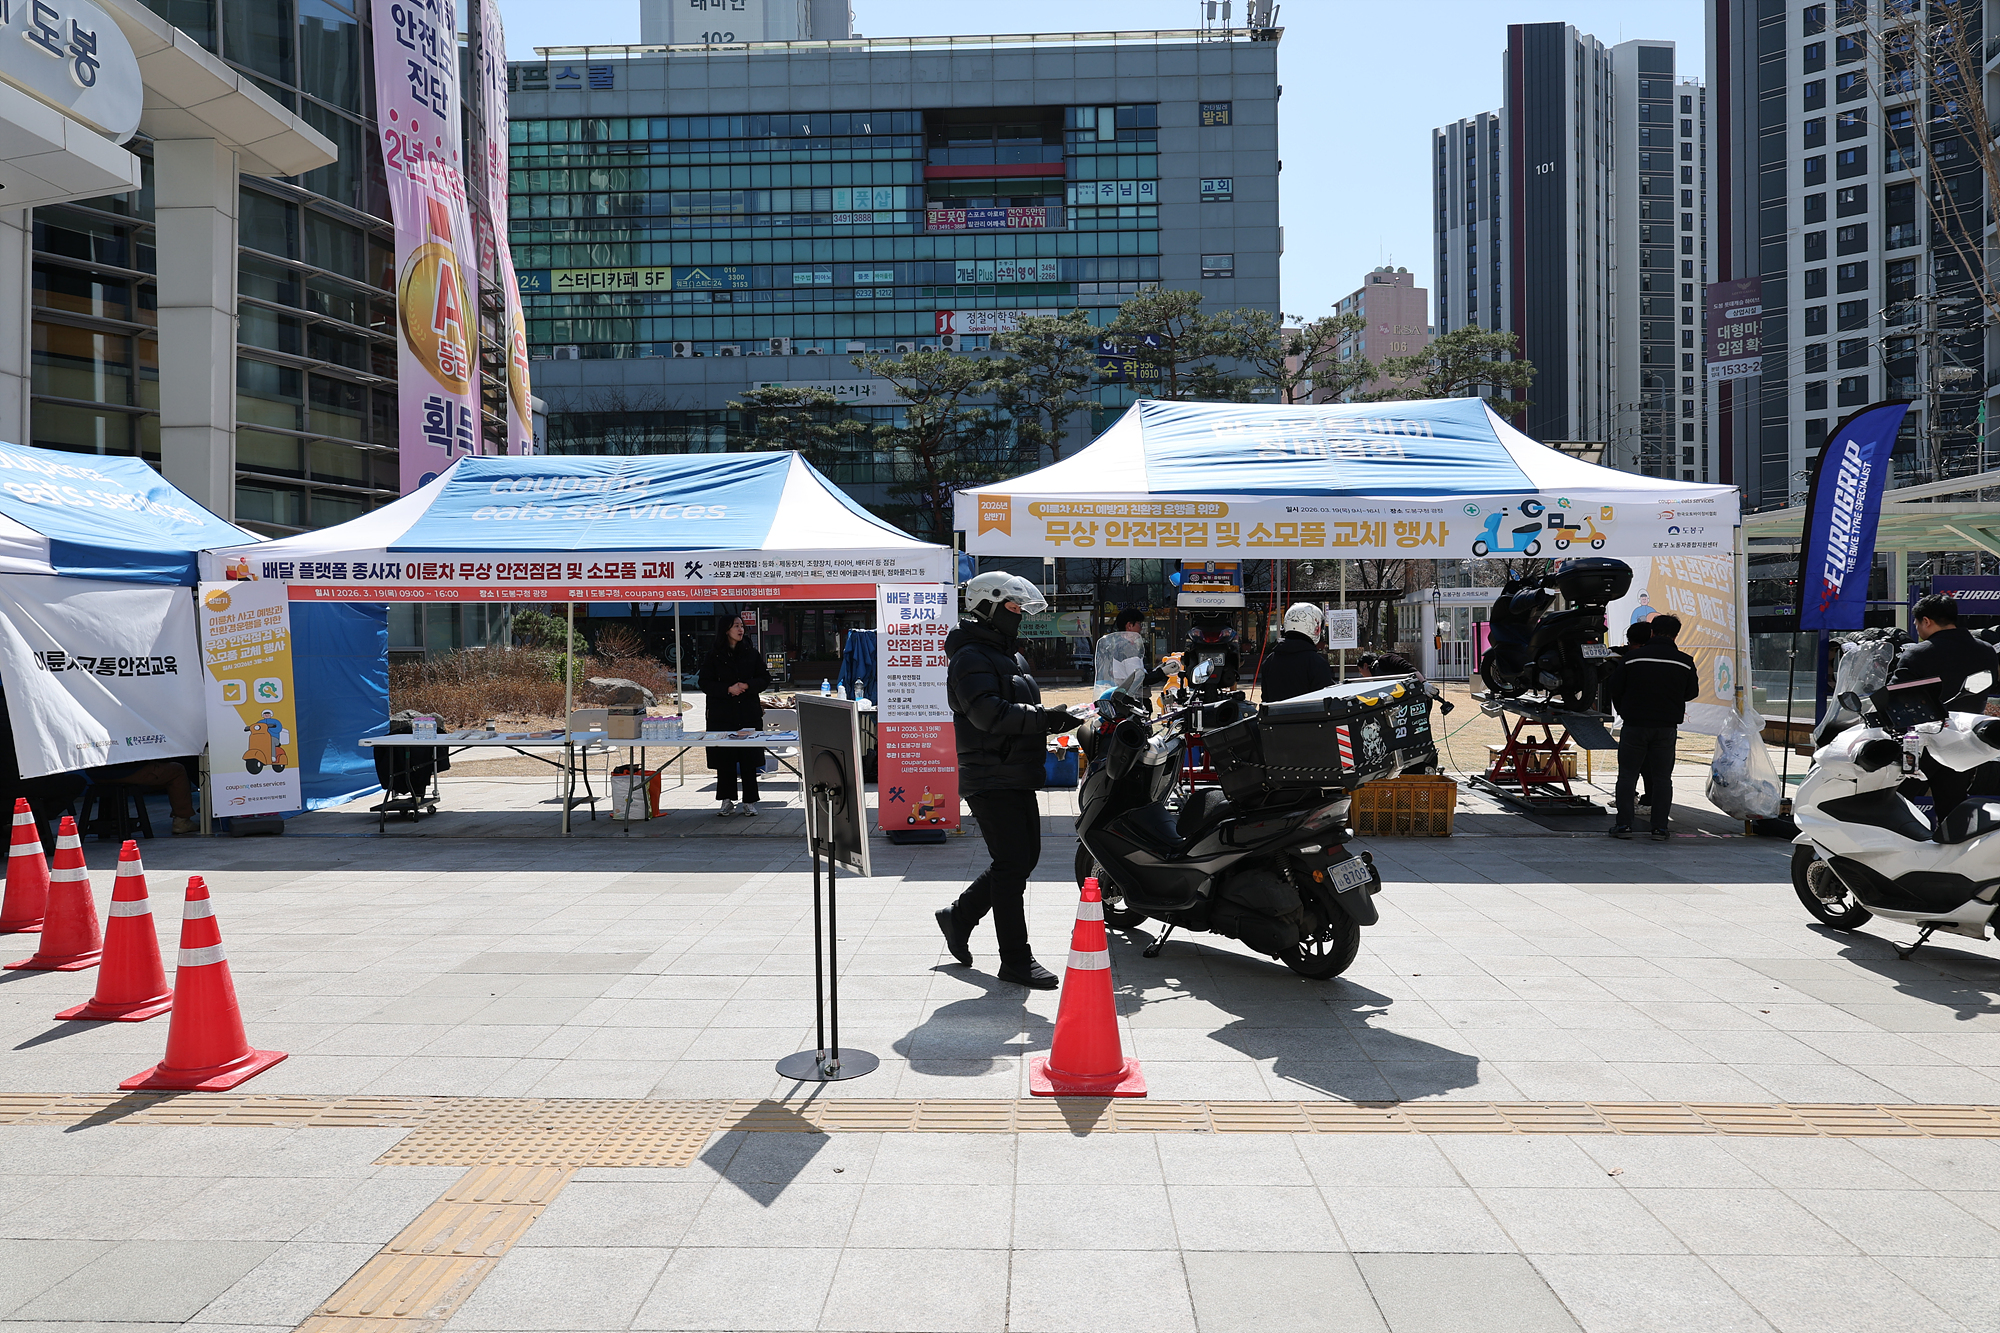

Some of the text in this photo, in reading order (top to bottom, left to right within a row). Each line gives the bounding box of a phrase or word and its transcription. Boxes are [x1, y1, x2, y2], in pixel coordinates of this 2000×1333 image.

[390, 3, 454, 82] 안전도
[701, 31, 735, 43] 102
[22, 0, 101, 88] 도봉
[406, 58, 449, 121] 진단
[1202, 110, 1229, 125] 발레
[1535, 161, 1555, 175] 101
[1101, 179, 1230, 196] 주님의 교회
[833, 213, 872, 223] 3491 3888
[928, 210, 966, 223] 월드풋샵
[987, 210, 1005, 218] 아로마
[1025, 207, 1046, 216] 5만원
[1007, 216, 1046, 228] 마사지
[1041, 263, 1056, 271] 3494
[557, 271, 665, 288] 스터디카페 5F
[814, 273, 832, 281] 피아노
[957, 266, 1036, 282] 개념 Plus 수학 영어
[1039, 272, 1056, 280] -2266
[434, 262, 466, 343] A
[1732, 307, 1757, 316] 상업시설
[966, 312, 1017, 325] 정철어학원
[968, 325, 998, 333] Speaking
[1389, 341, 1408, 352] 106
[1717, 339, 1743, 357] 입점
[438, 340, 468, 380] 등급
[1103, 361, 1139, 378] 수학
[1140, 369, 1159, 379] 0910
[489, 476, 654, 499] coupang
[3, 480, 205, 526] eats services
[981, 501, 1008, 510] 2026년
[1039, 503, 1220, 515] 이륜차 사고 예방과 친환경 운행을 위한
[471, 500, 728, 521] eats services
[983, 512, 1006, 521] 상반기
[1824, 439, 1861, 590] EUROGRIP
[1846, 461, 1873, 574] THE BIKE TYRE SPECIALIST
[1044, 520, 1450, 548] 무상 안전점검 및 소모품 교체 행사
[1682, 526, 1704, 534] 도봉구
[713, 560, 732, 568] 이륜차
[732, 560, 758, 568] 안전점검
[762, 560, 775, 568] 등화
[834, 559, 855, 567] 타이어,
[855, 559, 874, 567] 배터리
[262, 561, 675, 580] 배달 플랫폼 종사자 이륜차 무상 안전점검 및 소모품 교체
[763, 570, 784, 578] 오일류,
[826, 569, 839, 577] 엔진
[840, 569, 871, 577] 에어클리너
[872, 569, 886, 577] 필터,
[887, 568, 918, 576] 점화플러그
[919, 568, 926, 576] 등
[315, 588, 459, 598] 일시 2026. 19(목) 09:00 16:00
[479, 588, 781, 599] 장소 도봉구청 광장 주관 도봉구청, coupang eats, (사)한국 오토바이정비협회
[886, 592, 948, 604] 배달 플랫폼
[1202, 597, 1226, 605] barogo
[209, 605, 284, 627] 이륜차 사고 예방과
[900, 607, 936, 620] 종사자
[209, 615, 282, 636] 친환경운행을 위한
[887, 623, 949, 636] 이륜차 무상
[205, 626, 286, 651] 무상 안전점검 및
[887, 639, 934, 652] 안전점검
[206, 640, 286, 666] 소모품 교체 행사
[887, 655, 950, 668] 소모품 교체
[225, 783, 250, 791] coupang
[263, 780, 286, 788] services
[1343, 867, 1367, 885] 8709
